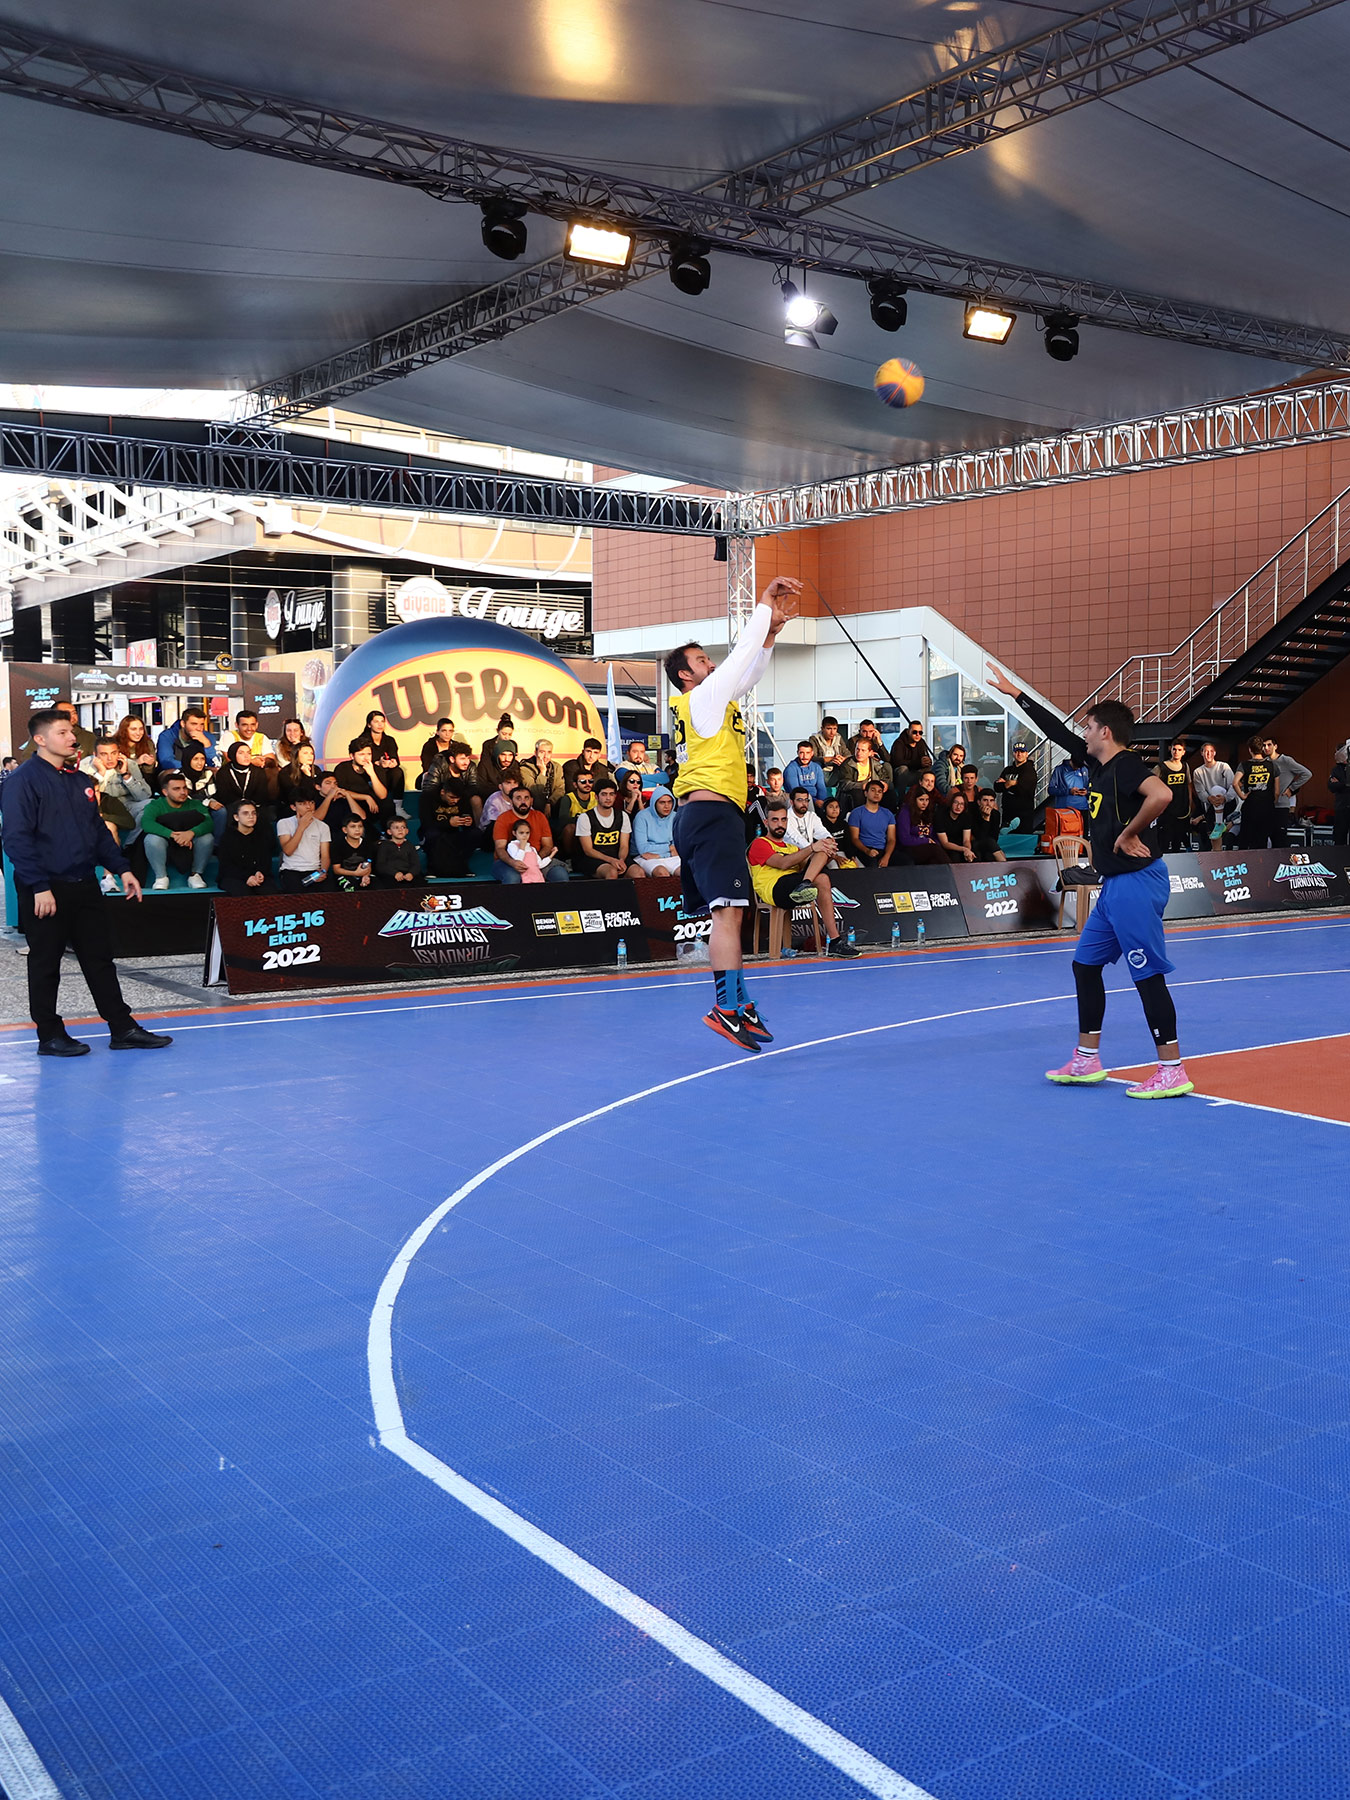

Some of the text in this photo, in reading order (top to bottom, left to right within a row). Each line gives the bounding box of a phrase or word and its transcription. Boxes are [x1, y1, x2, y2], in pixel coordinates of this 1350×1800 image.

[284, 590, 325, 632] Lounge
[116, 672, 158, 686] GÜLE
[160, 673, 203, 687] GÜLE!
[372, 668, 592, 734] Wilson
[1169, 775, 1184, 784] 3x3
[1249, 775, 1268, 783] 3x3
[596, 832, 618, 844] 3x3
[1210, 863, 1248, 881] 14-15-16
[1275, 862, 1337, 880] BASKETBOL
[970, 874, 1017, 893] 14-15-16
[1224, 877, 1242, 888] Ekim
[1289, 877, 1328, 889] TURNUVASI
[932, 899, 958, 907] KONYA
[986, 890, 1008, 901] Ekim
[1223, 886, 1251, 904] 2022
[604, 911, 632, 921] SPOR
[984, 900, 1018, 918] 2022
[244, 910, 325, 936] 14-15-16
[383, 906, 511, 931] BASKETBOL
[606, 917, 641, 928] KONYA
[268, 931, 307, 947] Ekim
[411, 928, 489, 948] TURNUVASI
[262, 944, 320, 970] 2022
